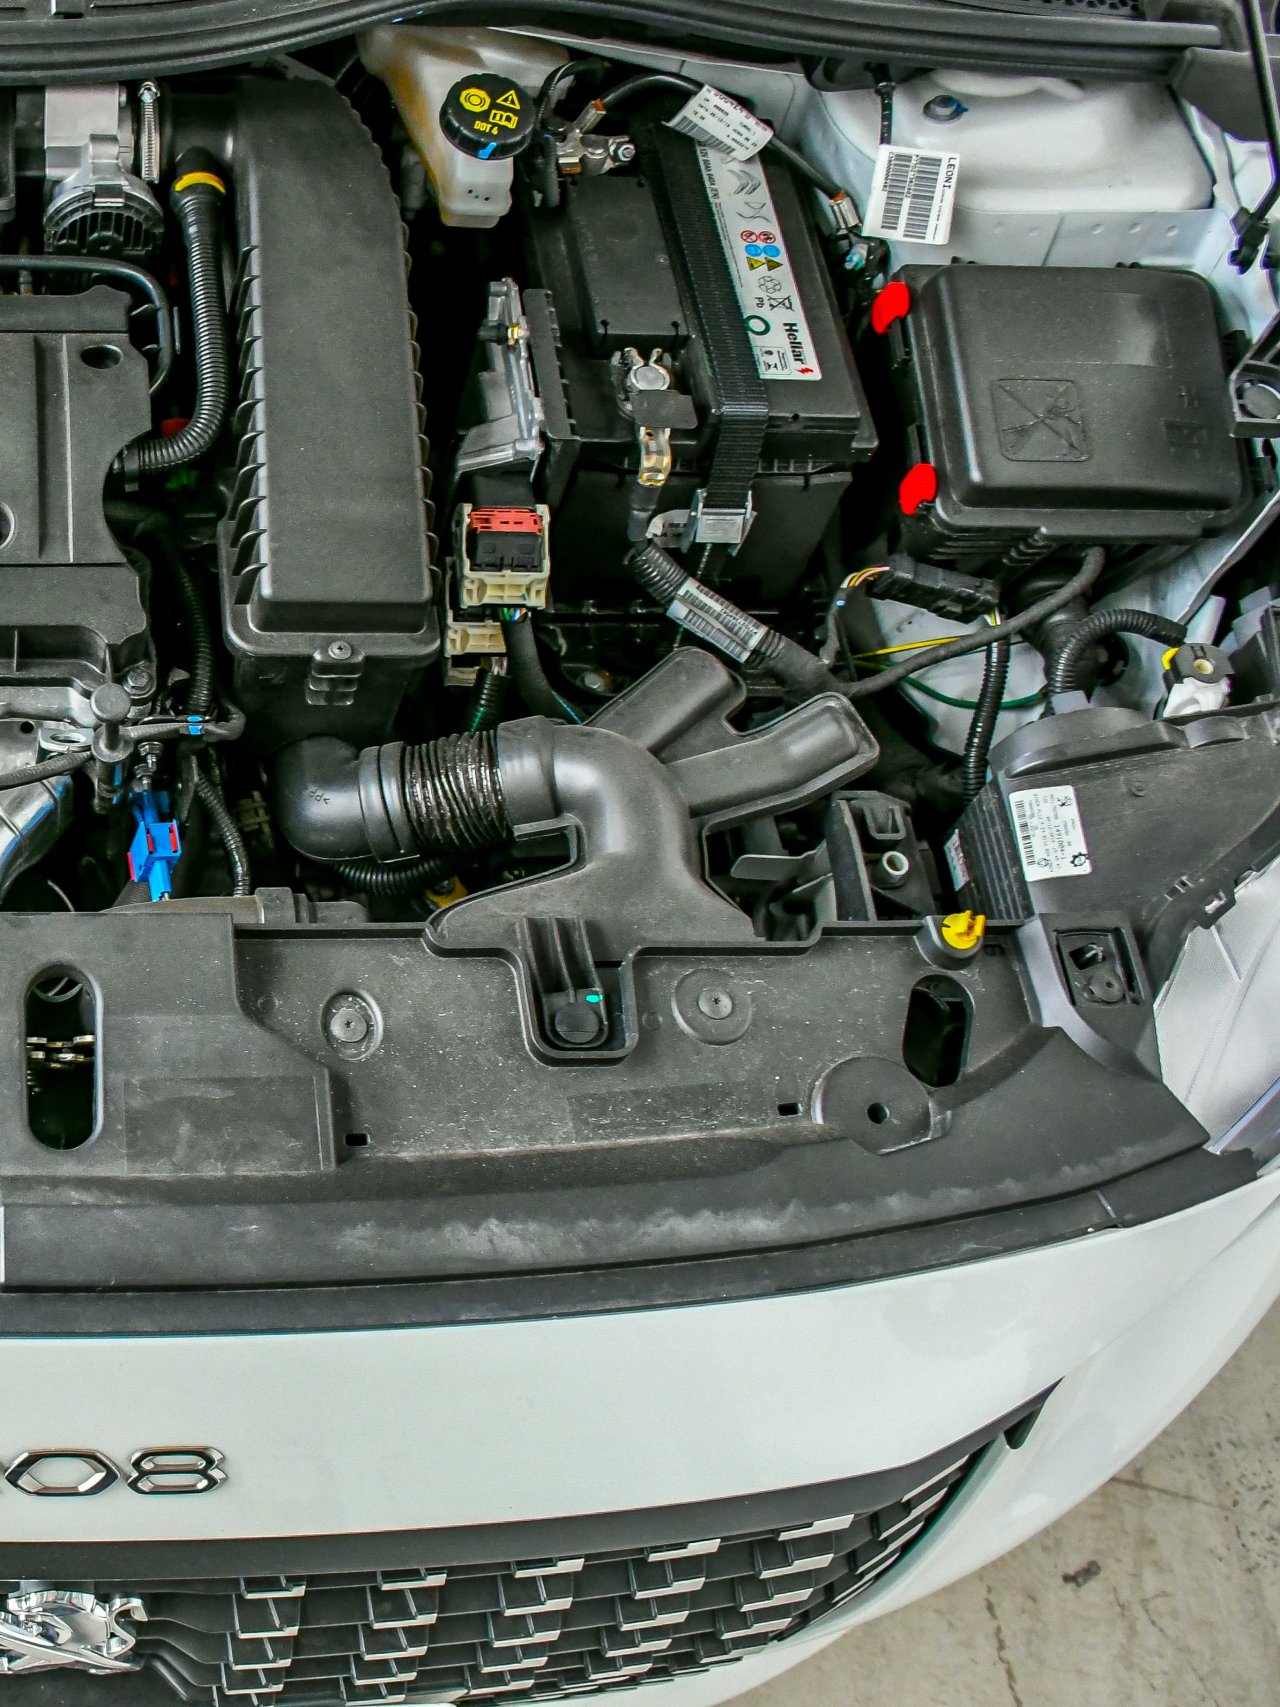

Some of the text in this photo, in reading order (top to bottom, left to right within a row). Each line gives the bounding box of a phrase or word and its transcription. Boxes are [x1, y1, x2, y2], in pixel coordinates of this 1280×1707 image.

[473, 120, 499, 136] DOT 4
[942, 156, 958, 190] LEONI
[754, 296, 765, 309] Pb
[782, 322, 805, 365] Heliar
